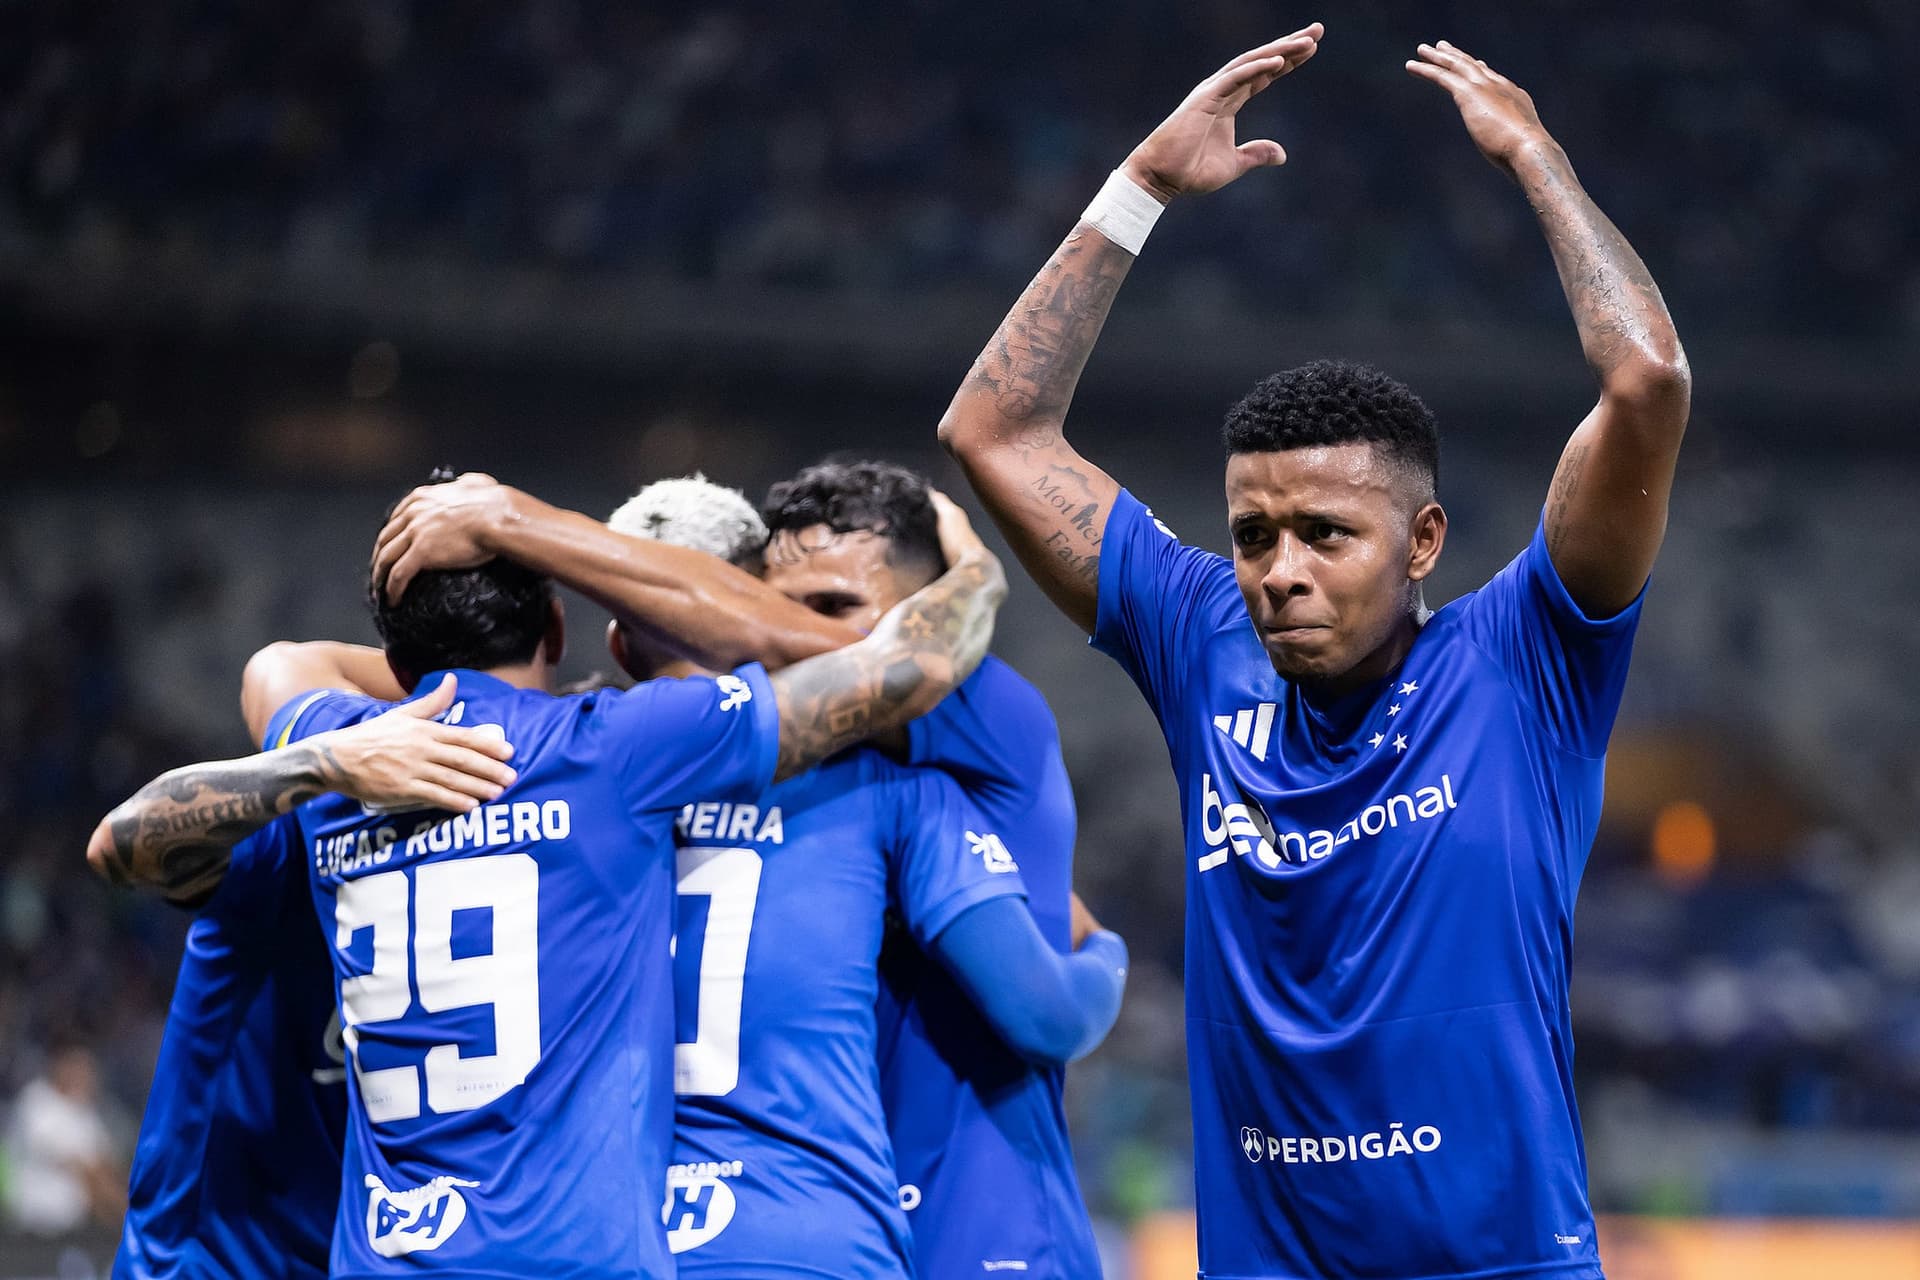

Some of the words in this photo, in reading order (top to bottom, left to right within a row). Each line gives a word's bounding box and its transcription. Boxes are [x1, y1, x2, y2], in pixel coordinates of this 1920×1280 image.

[315, 826, 398, 877] LUCAS
[405, 799, 571, 857] ROMERO
[335, 853, 542, 1123] 29
[1266, 1122, 1442, 1164] PERDIGÃO
